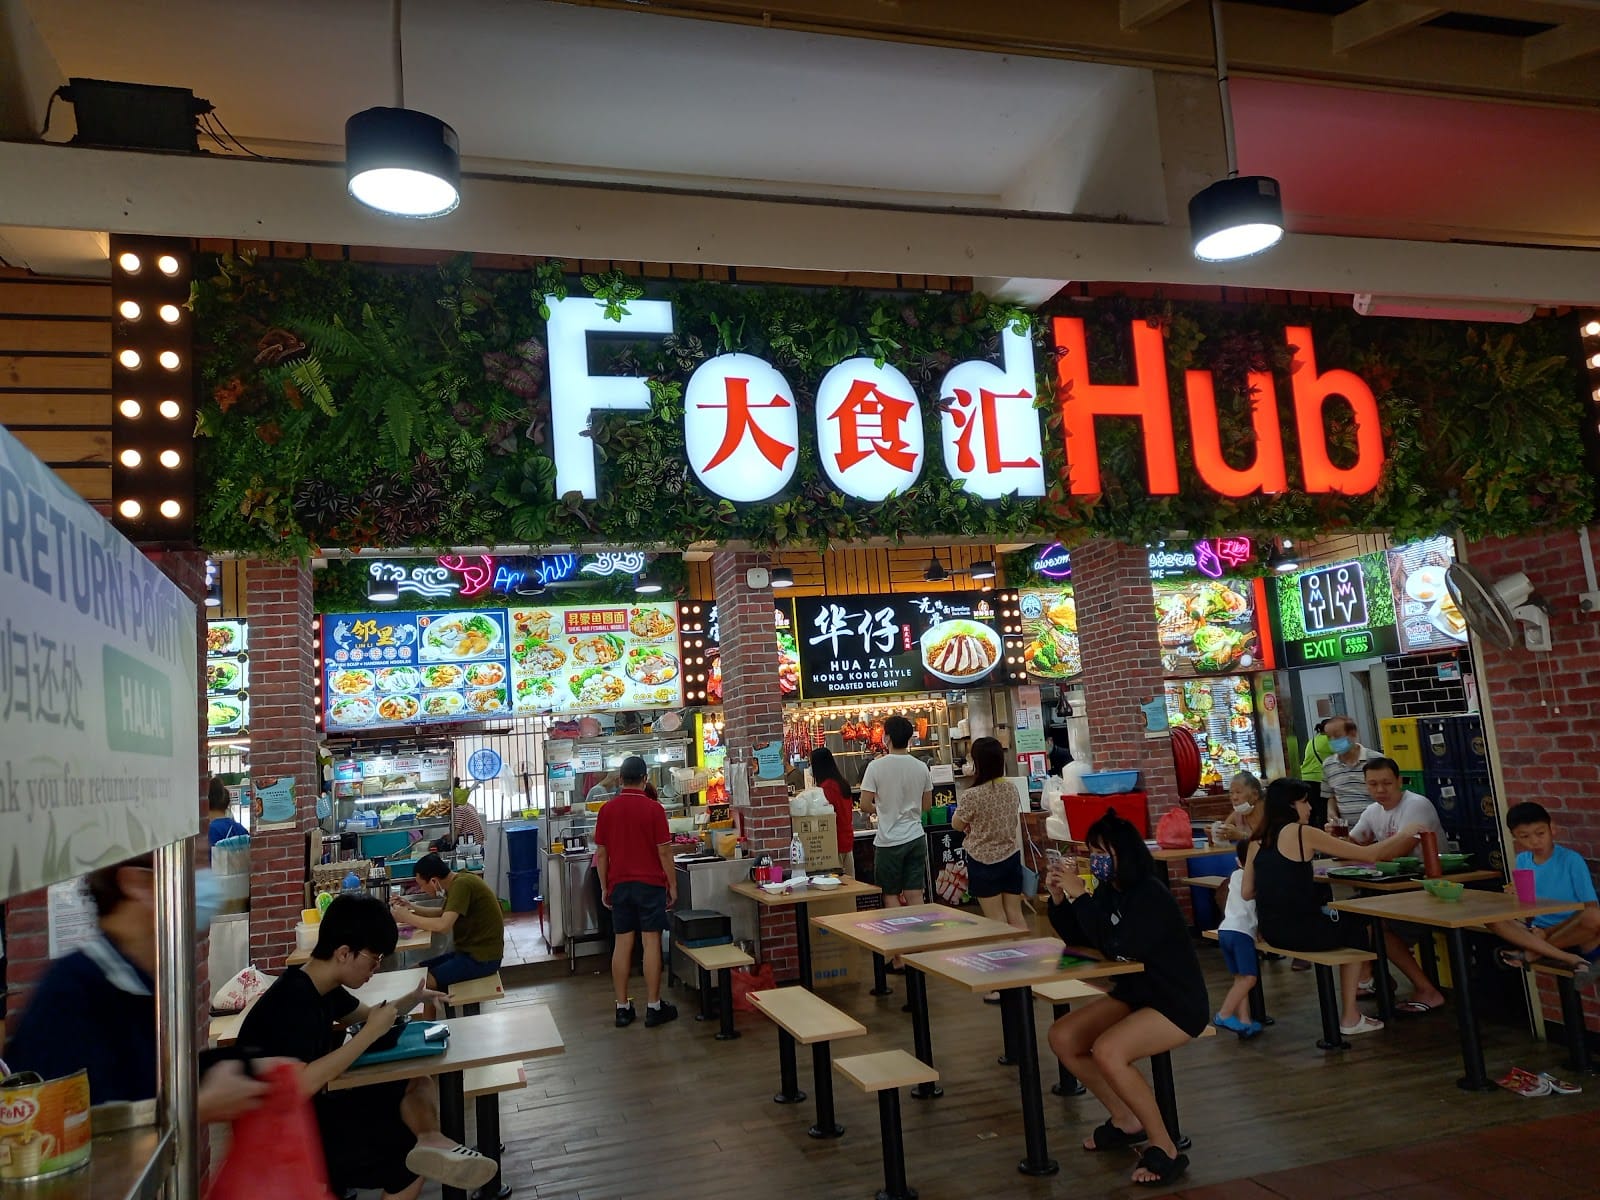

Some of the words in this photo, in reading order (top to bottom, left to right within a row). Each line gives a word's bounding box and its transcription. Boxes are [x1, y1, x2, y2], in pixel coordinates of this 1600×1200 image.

[544, 295, 1047, 502] Food
[1052, 316, 1385, 498] Hub
[1222, 540, 1248, 557] Like
[0, 464, 127, 636] RETURN
[129, 568, 178, 666] POINT
[1034, 553, 1071, 570] awesom
[808, 603, 900, 659] 华仔
[1303, 638, 1336, 659] EXIT
[830, 659, 862, 672] HUA
[868, 657, 894, 670] ZAI
[812, 673, 844, 683] HONG
[849, 671, 879, 681] KONG
[883, 669, 912, 678] STYLE
[828, 682, 864, 691] ROASTED
[866, 680, 898, 689] DELIGHT
[119, 674, 166, 740] HALAL
[26, 776, 60, 823] you
[64, 761, 85, 807] for
[89, 764, 140, 809] returning
